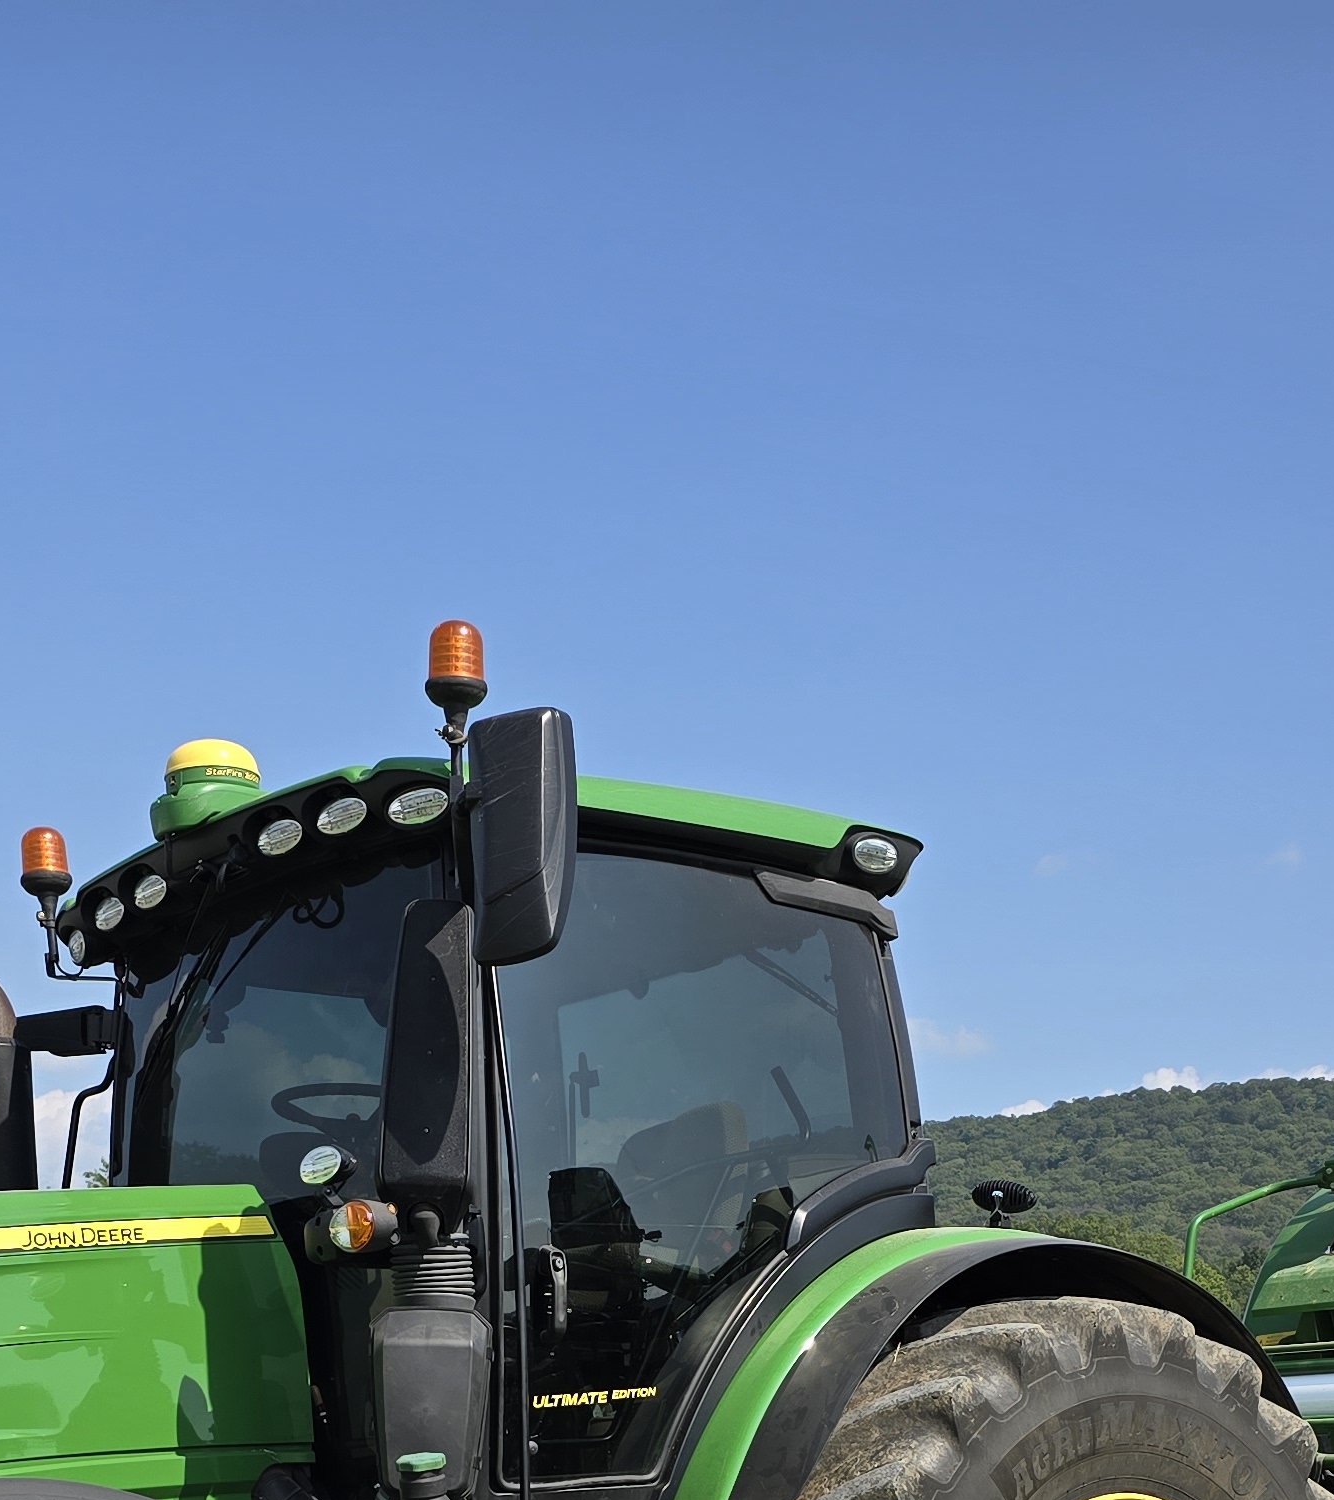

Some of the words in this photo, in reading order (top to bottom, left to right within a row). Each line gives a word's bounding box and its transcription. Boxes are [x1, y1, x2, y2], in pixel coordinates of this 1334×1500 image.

[205, 767, 243, 778] StarFire
[22, 1230, 76, 1248] JOHN
[80, 1227, 145, 1244] DEERE
[532, 1390, 609, 1409] ULTIMATE
[611, 1386, 657, 1400] EDITION
